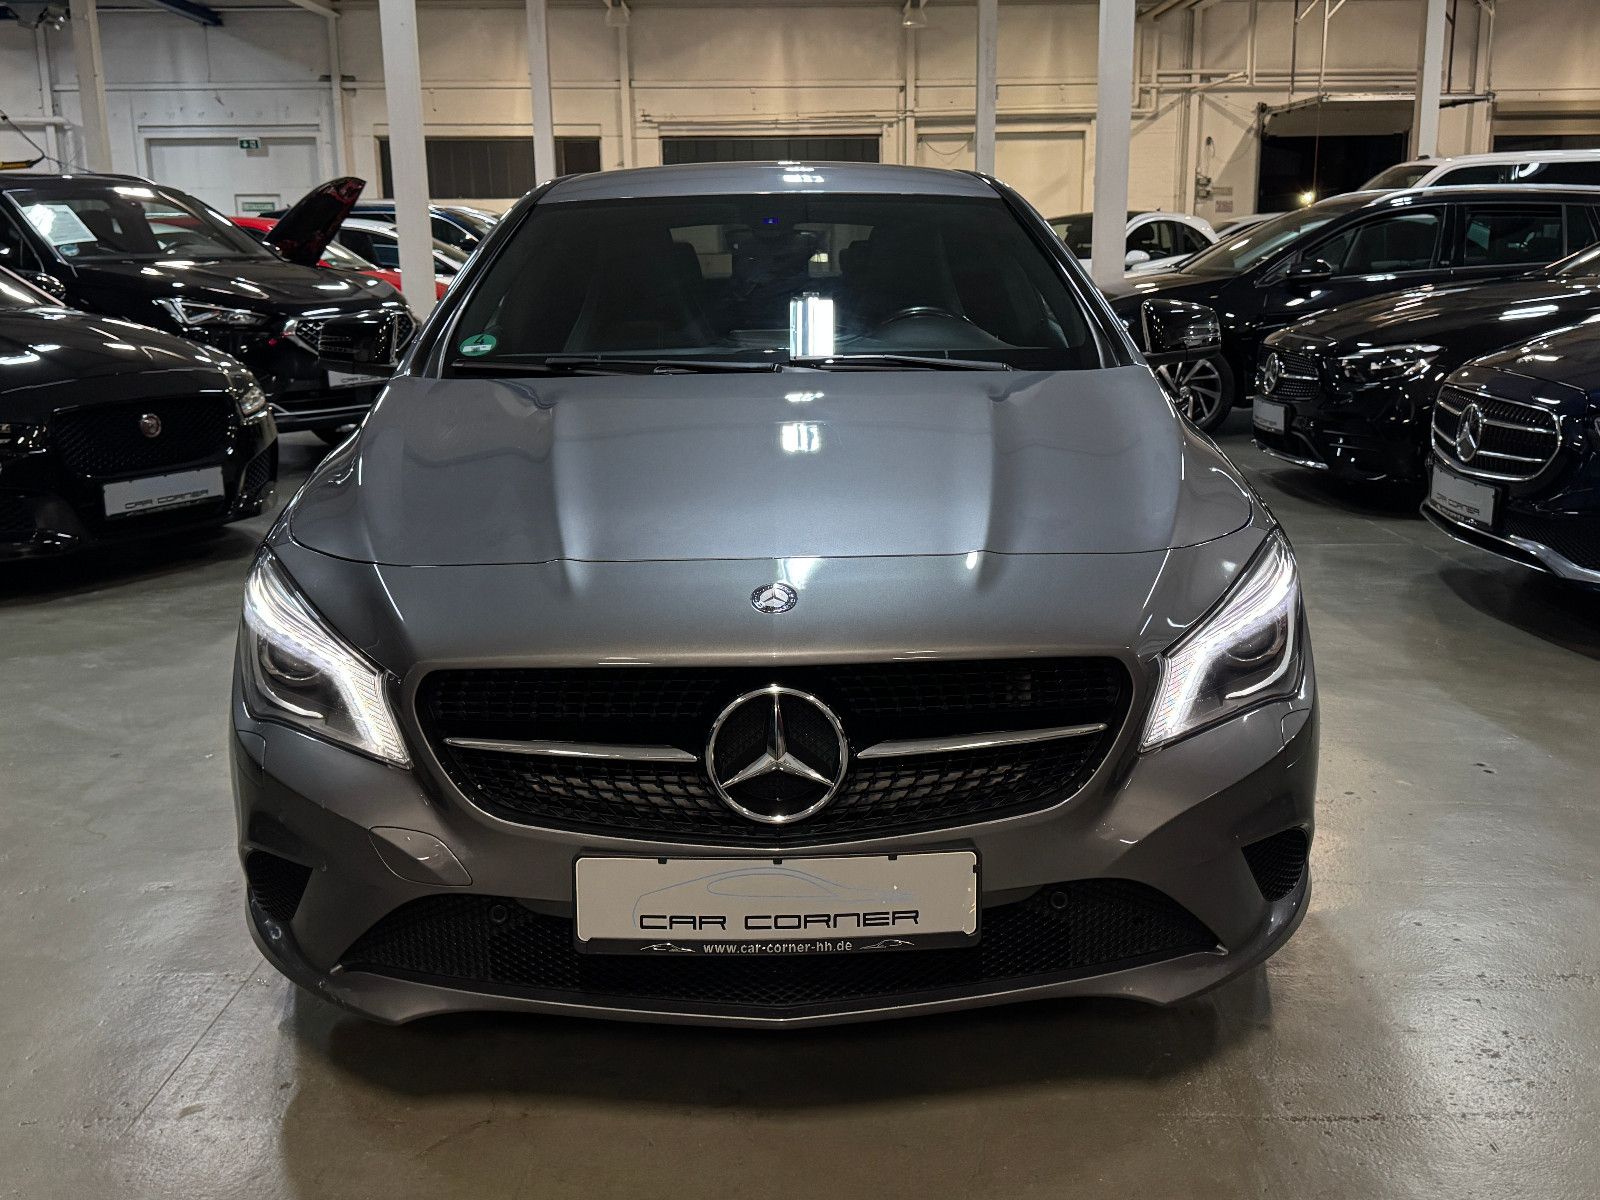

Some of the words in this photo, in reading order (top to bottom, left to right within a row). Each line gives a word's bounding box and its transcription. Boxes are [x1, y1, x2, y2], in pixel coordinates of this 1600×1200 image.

[474, 334, 485, 345] 4
[125, 499, 153, 509] CAR
[157, 489, 209, 504] CORNER
[640, 914, 727, 930] CAR
[744, 909, 919, 930] CORNER
[703, 941, 853, 954] www.car-corner-hh.de
